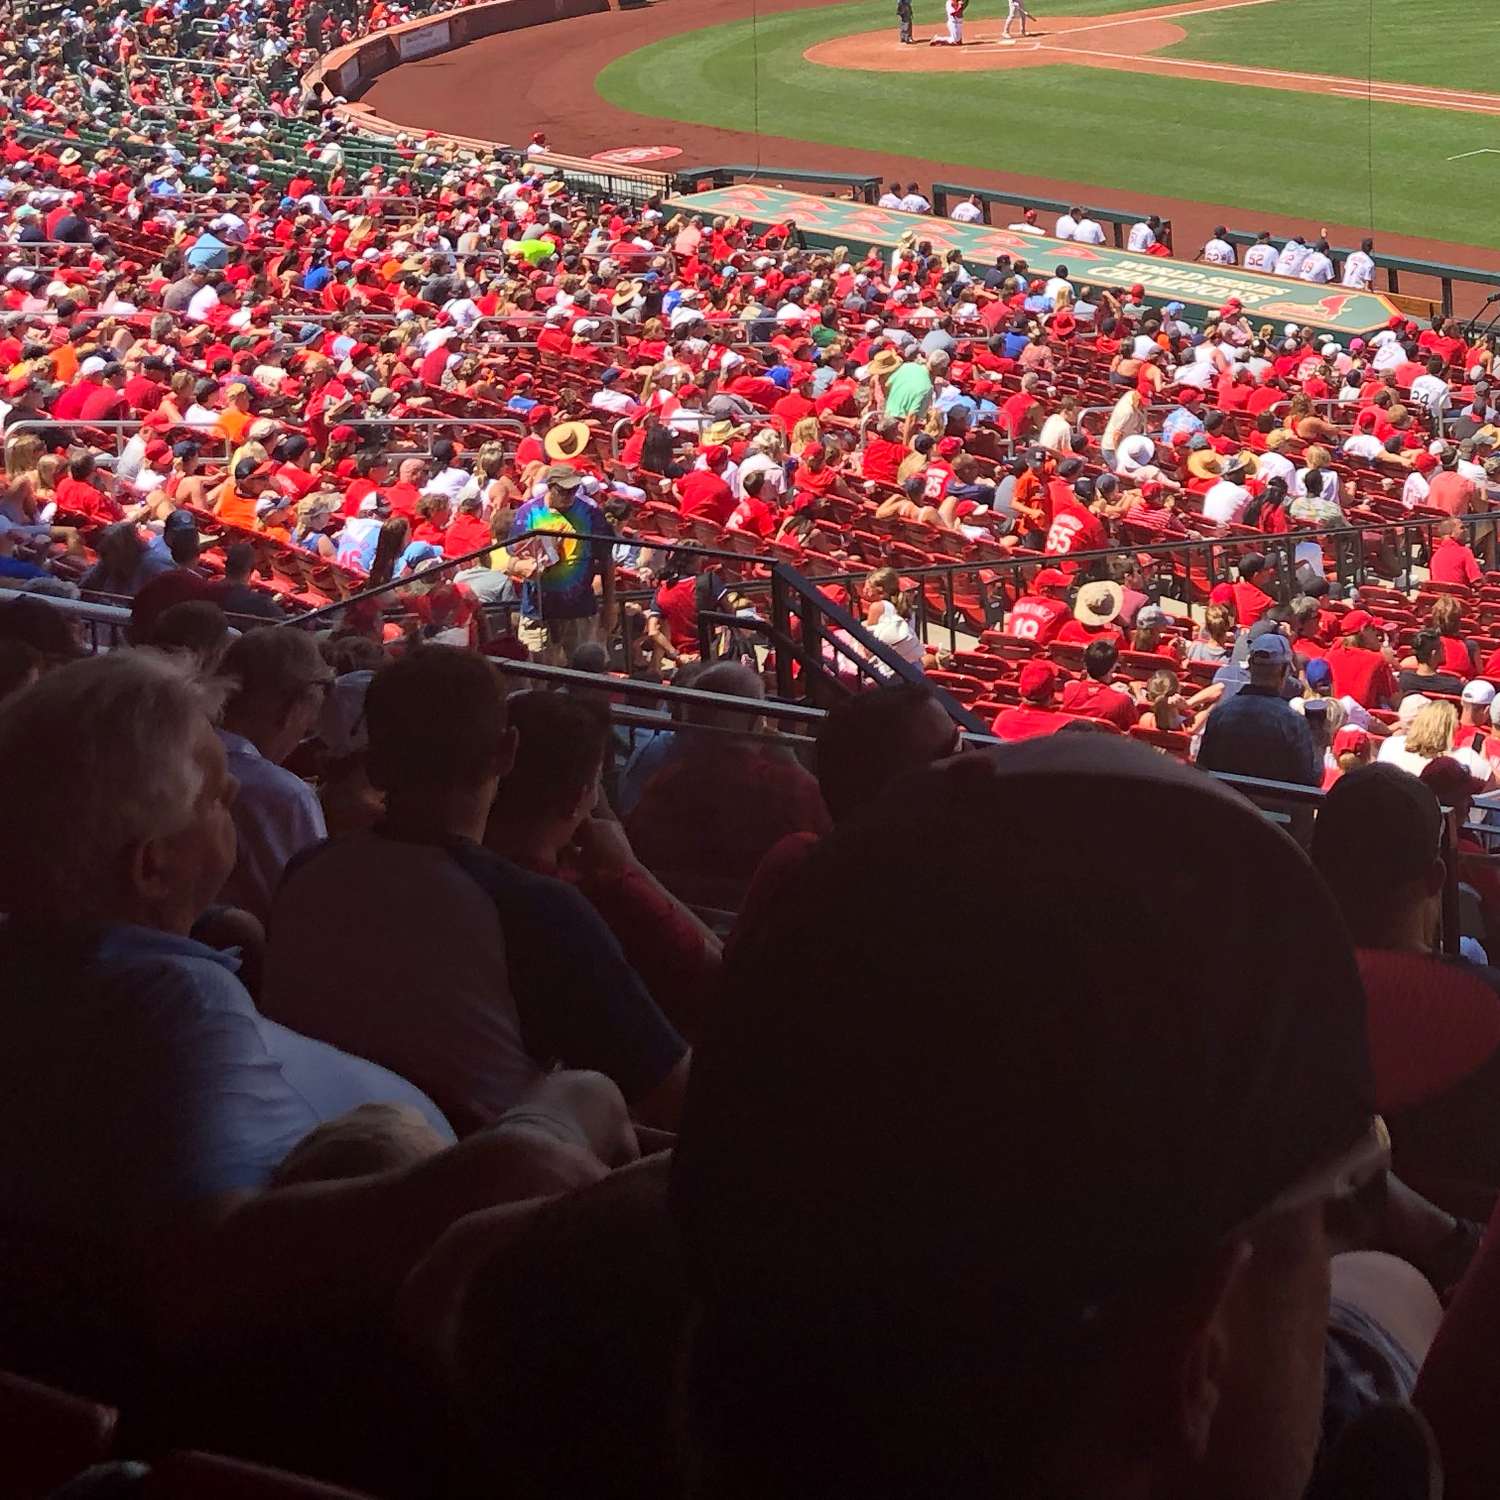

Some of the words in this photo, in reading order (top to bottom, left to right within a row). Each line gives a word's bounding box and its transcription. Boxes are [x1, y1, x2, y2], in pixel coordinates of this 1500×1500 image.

[1087, 266, 1271, 304] CHAMPIONS
[1115, 260, 1206, 280] WORLD
[1208, 276, 1292, 297] SERIES
[1047, 524, 1075, 553] 55
